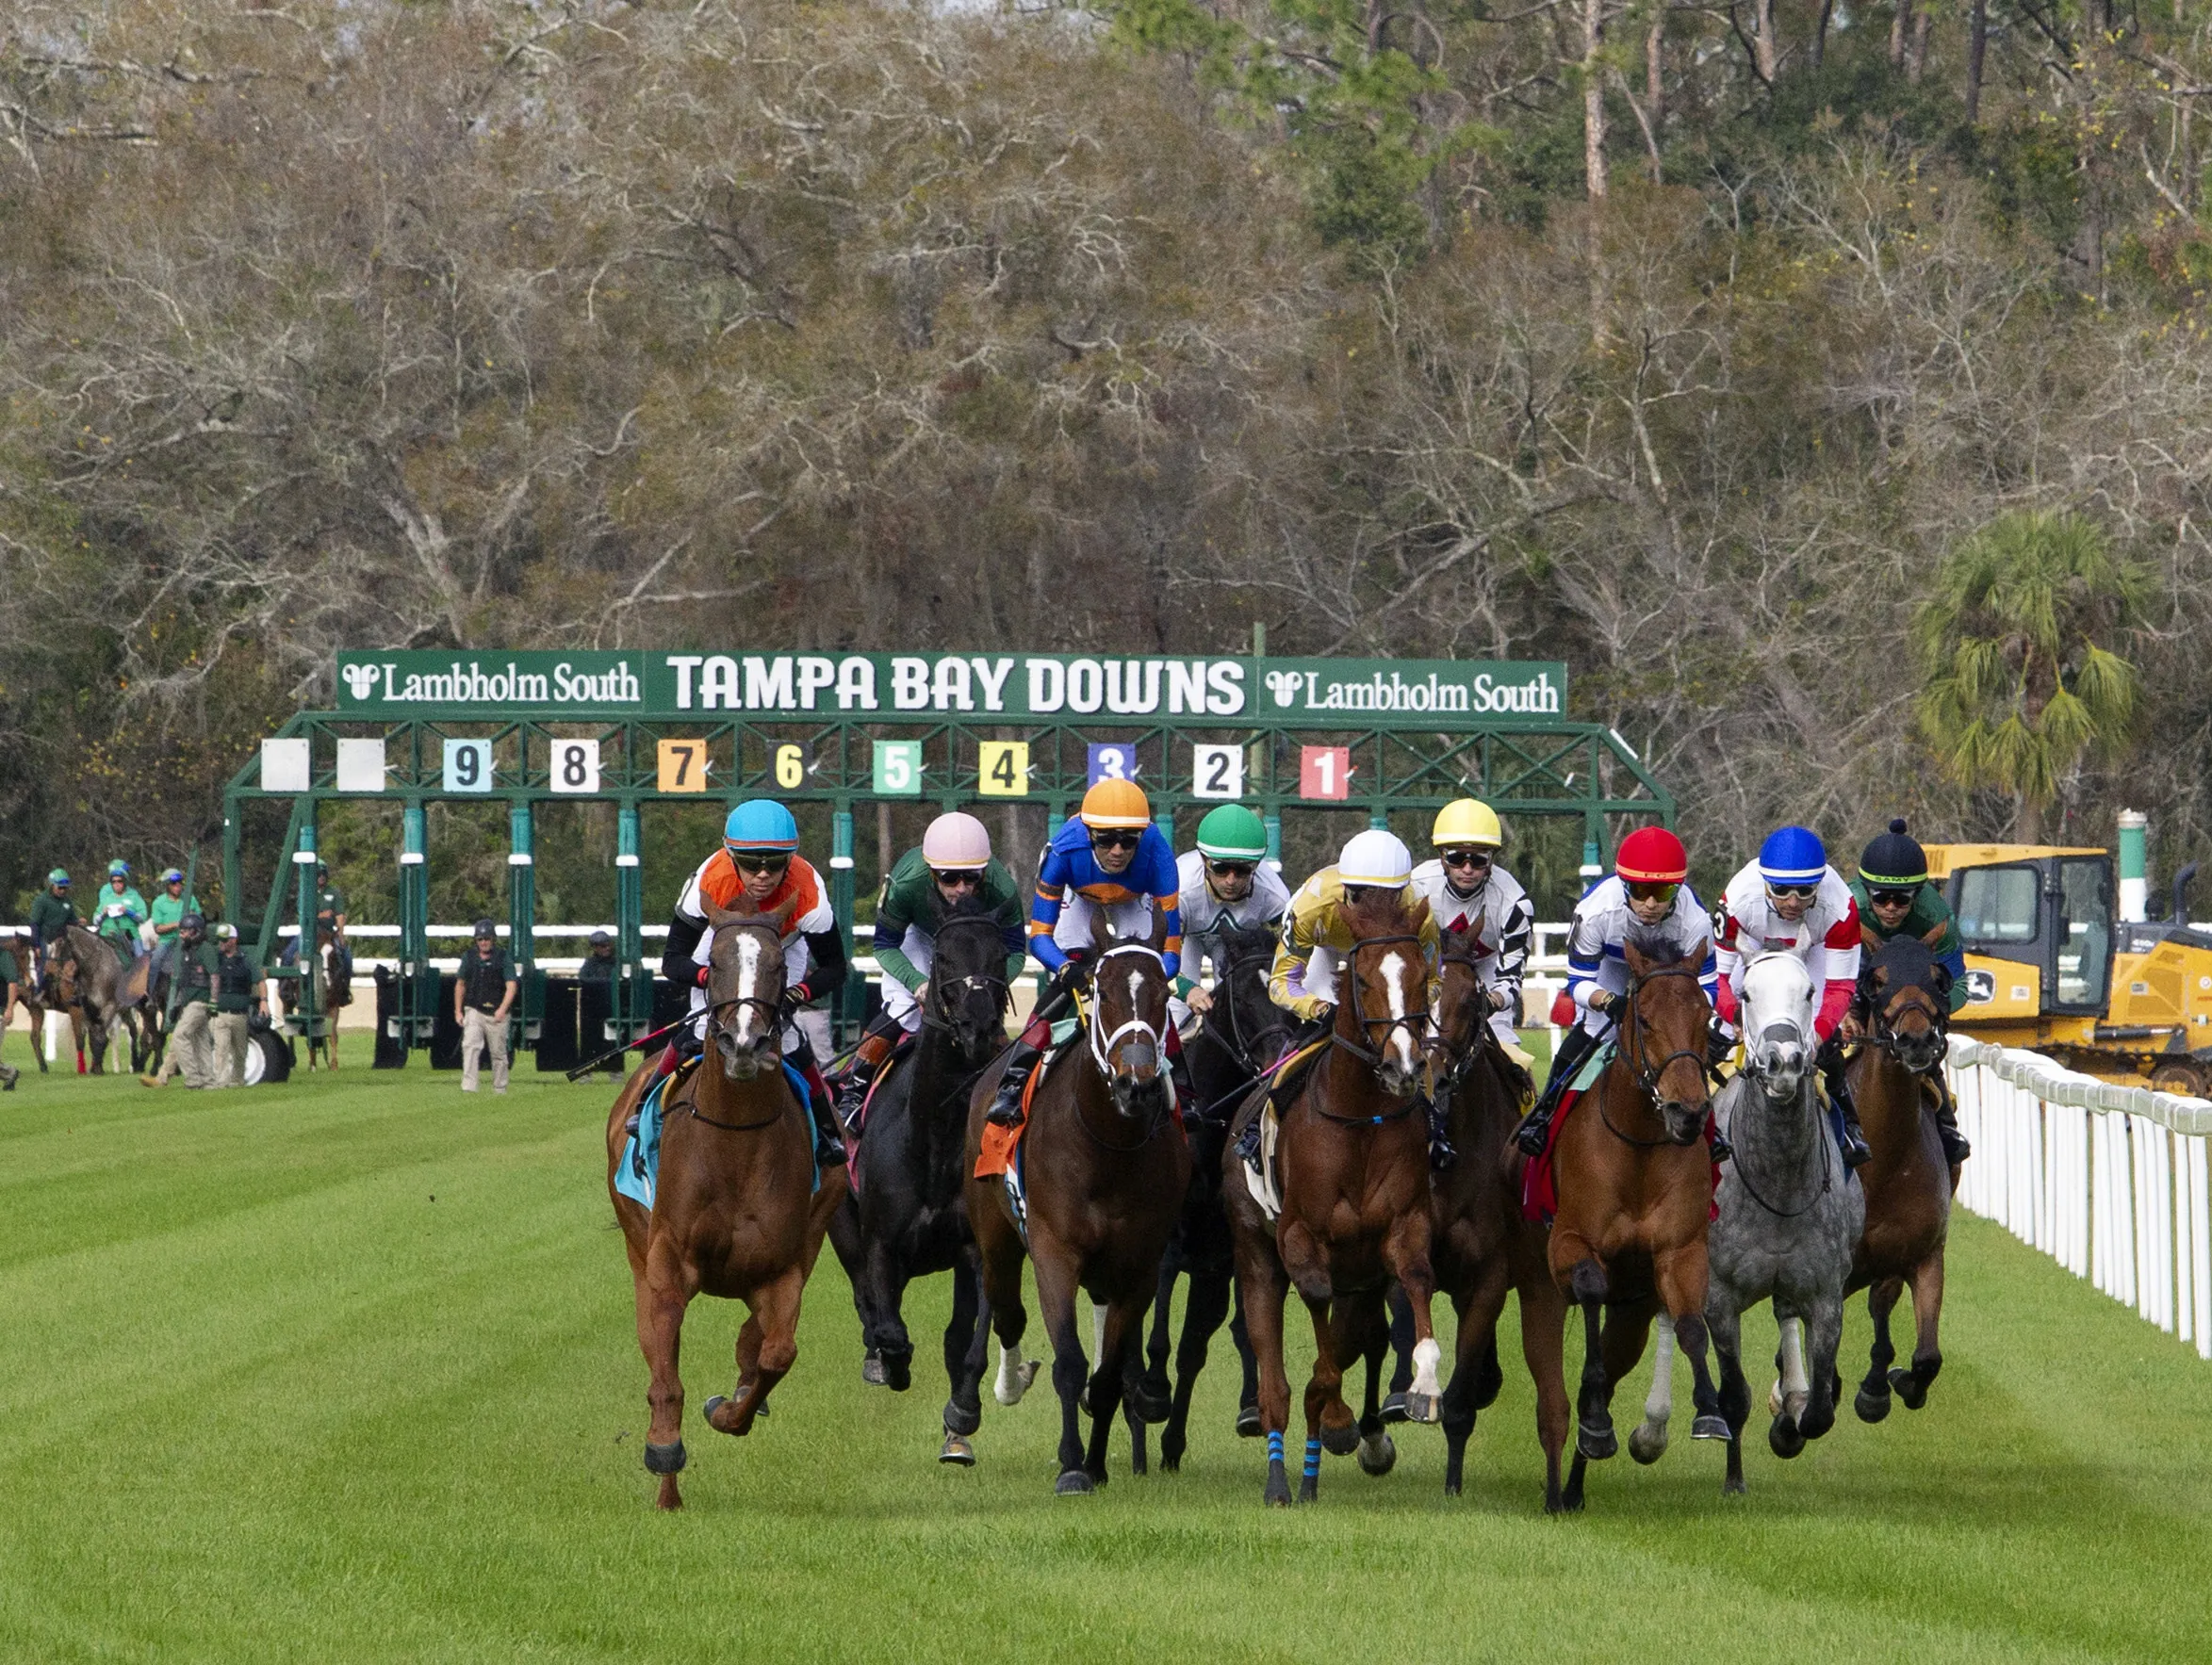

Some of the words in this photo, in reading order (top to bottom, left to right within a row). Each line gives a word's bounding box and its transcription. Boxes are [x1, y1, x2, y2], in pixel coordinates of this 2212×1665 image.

[382, 661, 549, 702] Lambholm
[553, 661, 640, 702] South
[665, 656, 878, 710] TAMPA
[891, 657, 1014, 712] BAY
[1024, 658, 1245, 715] DOWNS
[1303, 671, 1470, 711] Lambholm
[1474, 672, 1560, 713] South
[456, 745, 480, 786] 9
[563, 745, 587, 786] 8
[670, 746, 695, 786] 7
[777, 745, 803, 788] 6
[884, 745, 910, 789] 5
[991, 750, 1016, 788] 4
[1098, 747, 1125, 783] 3
[1206, 752, 1230, 792] 2
[1314, 751, 1335, 794] 1
[1713, 911, 1725, 939] 3
